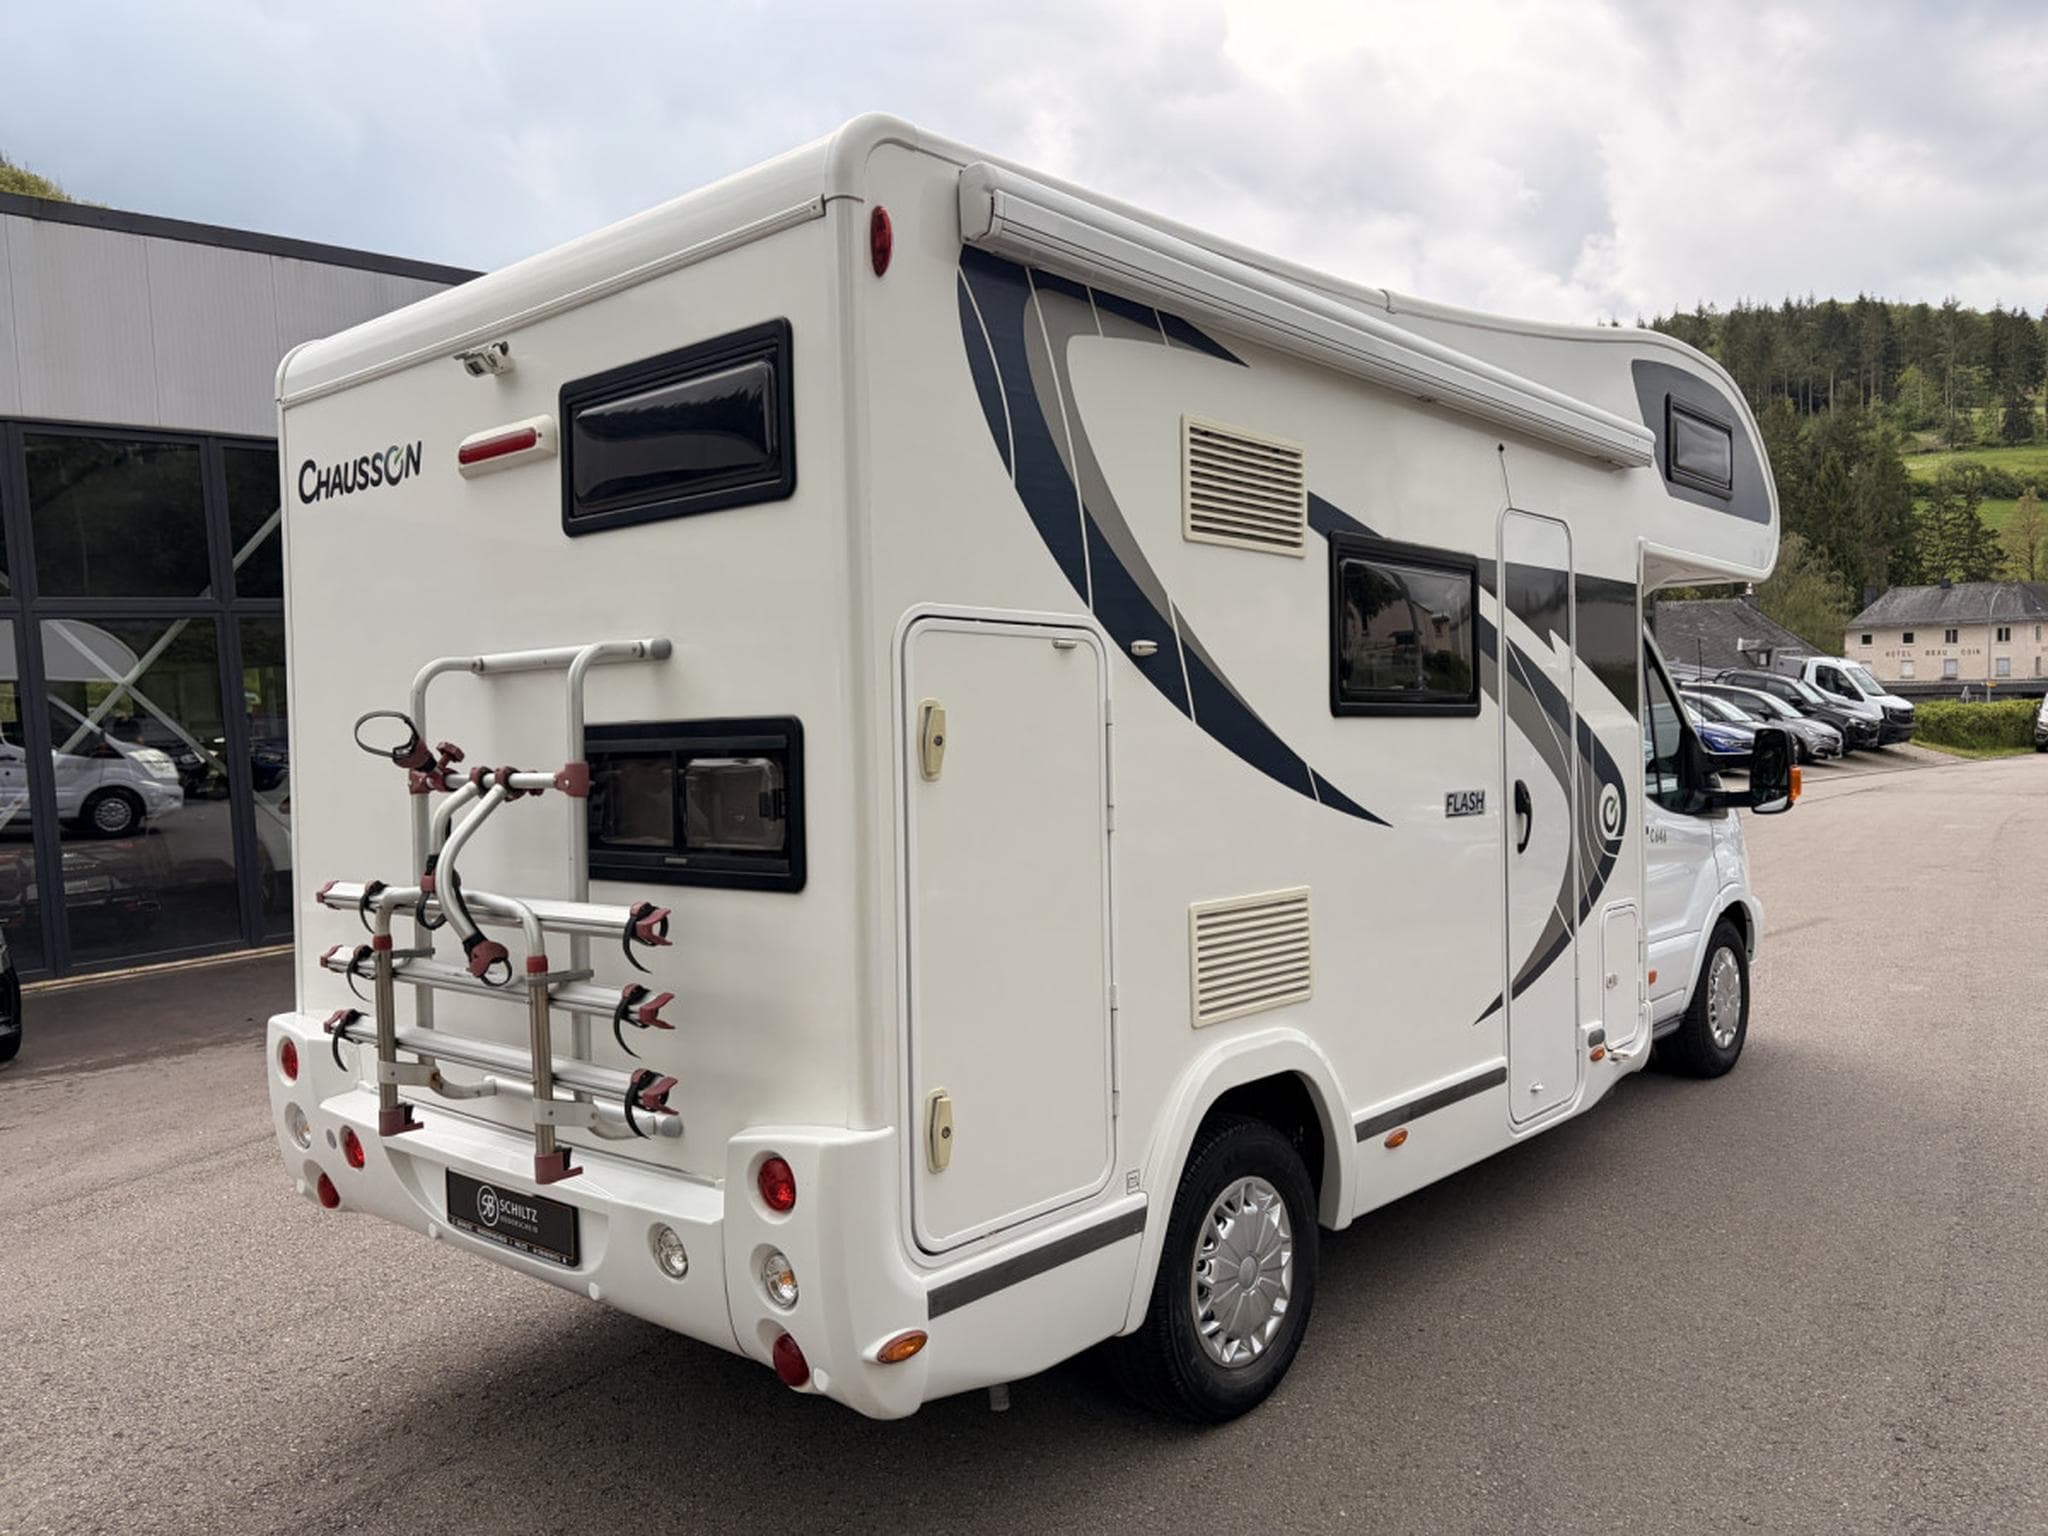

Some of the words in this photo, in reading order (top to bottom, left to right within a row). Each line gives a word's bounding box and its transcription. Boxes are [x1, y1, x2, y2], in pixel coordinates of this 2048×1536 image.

[298, 440, 422, 505] CHAUSSON
[1446, 791, 1485, 812] FLASH
[500, 1199, 538, 1223] SCHILTZ
